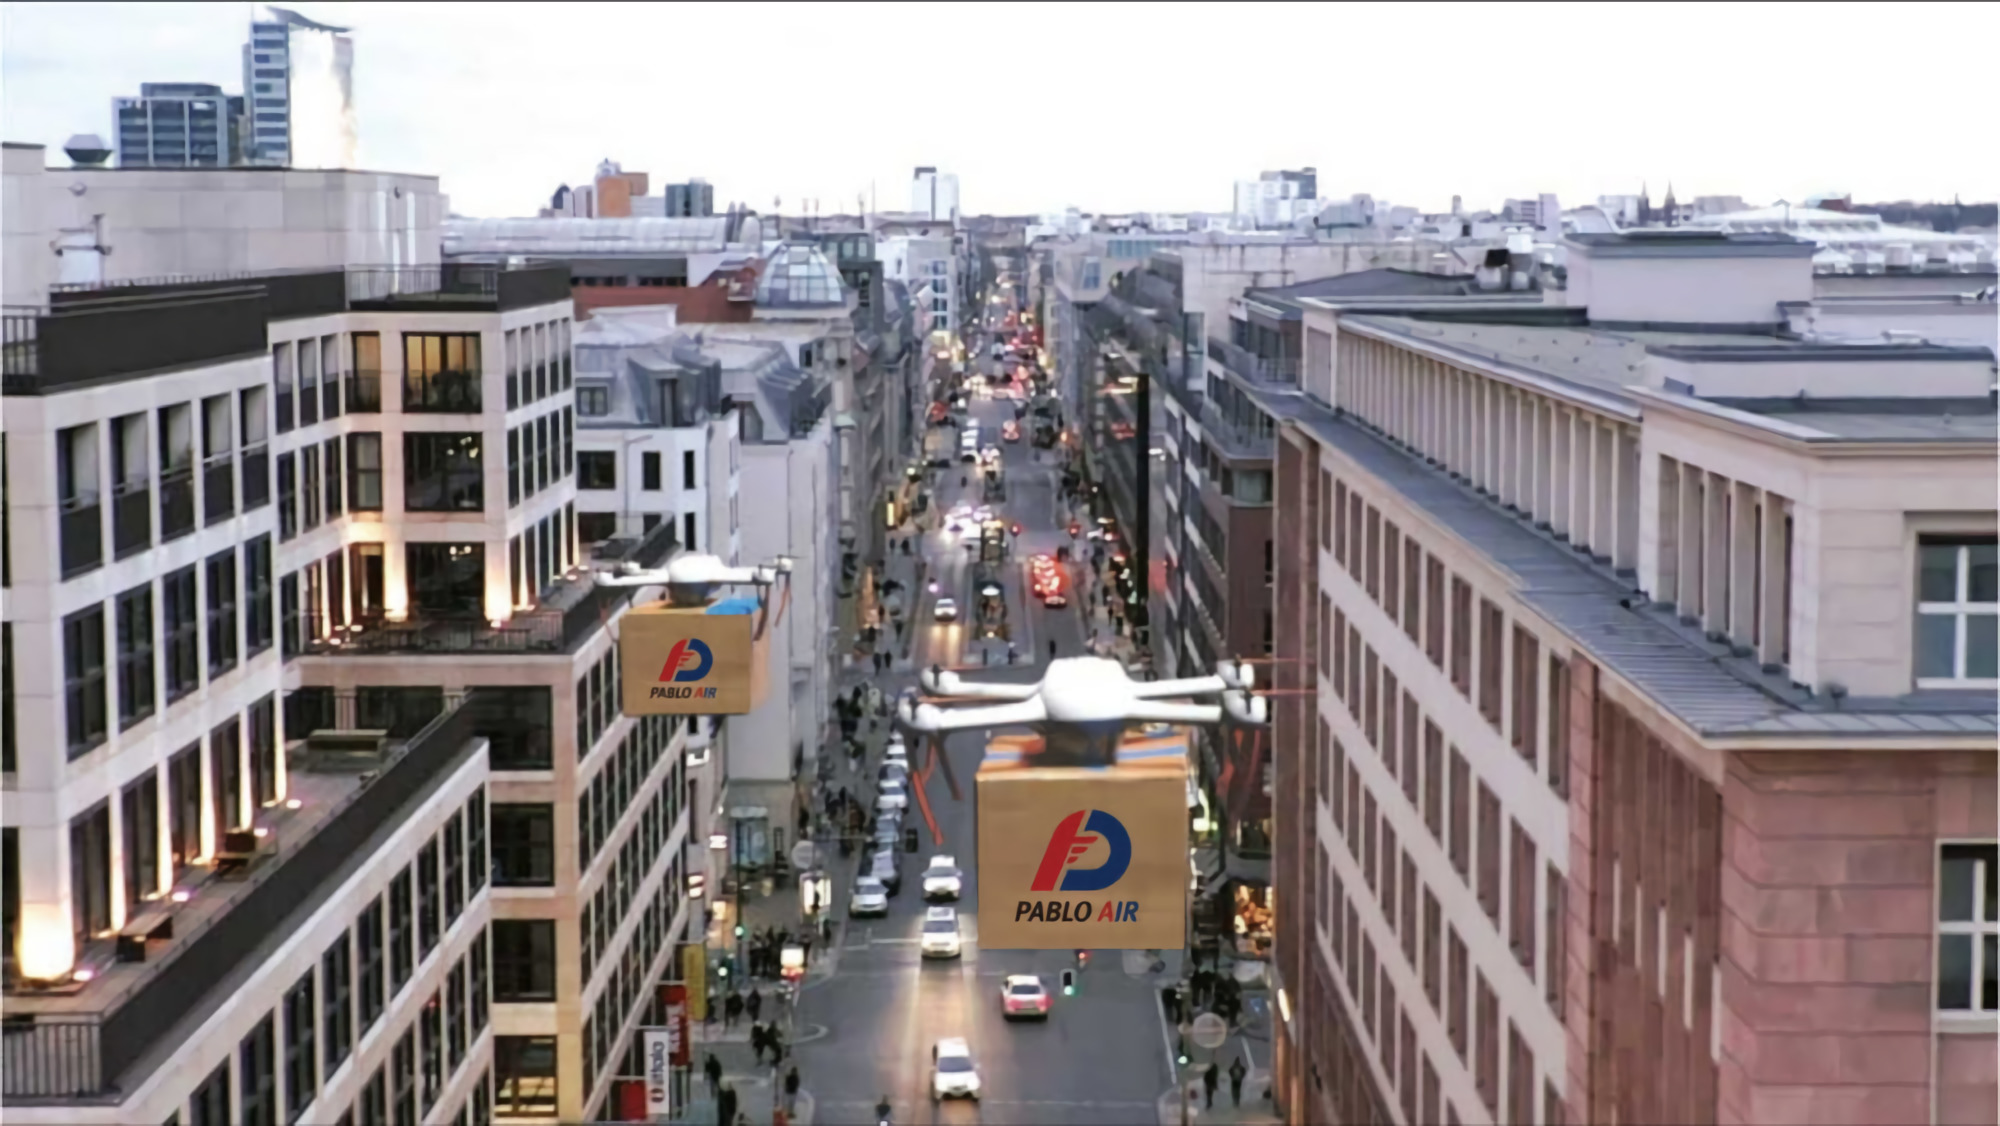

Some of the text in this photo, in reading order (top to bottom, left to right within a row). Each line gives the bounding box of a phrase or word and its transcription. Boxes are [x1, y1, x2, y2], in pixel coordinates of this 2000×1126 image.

[649, 686, 718, 699] PABLO AIR
[1014, 900, 1140, 923] PABLO AIR
